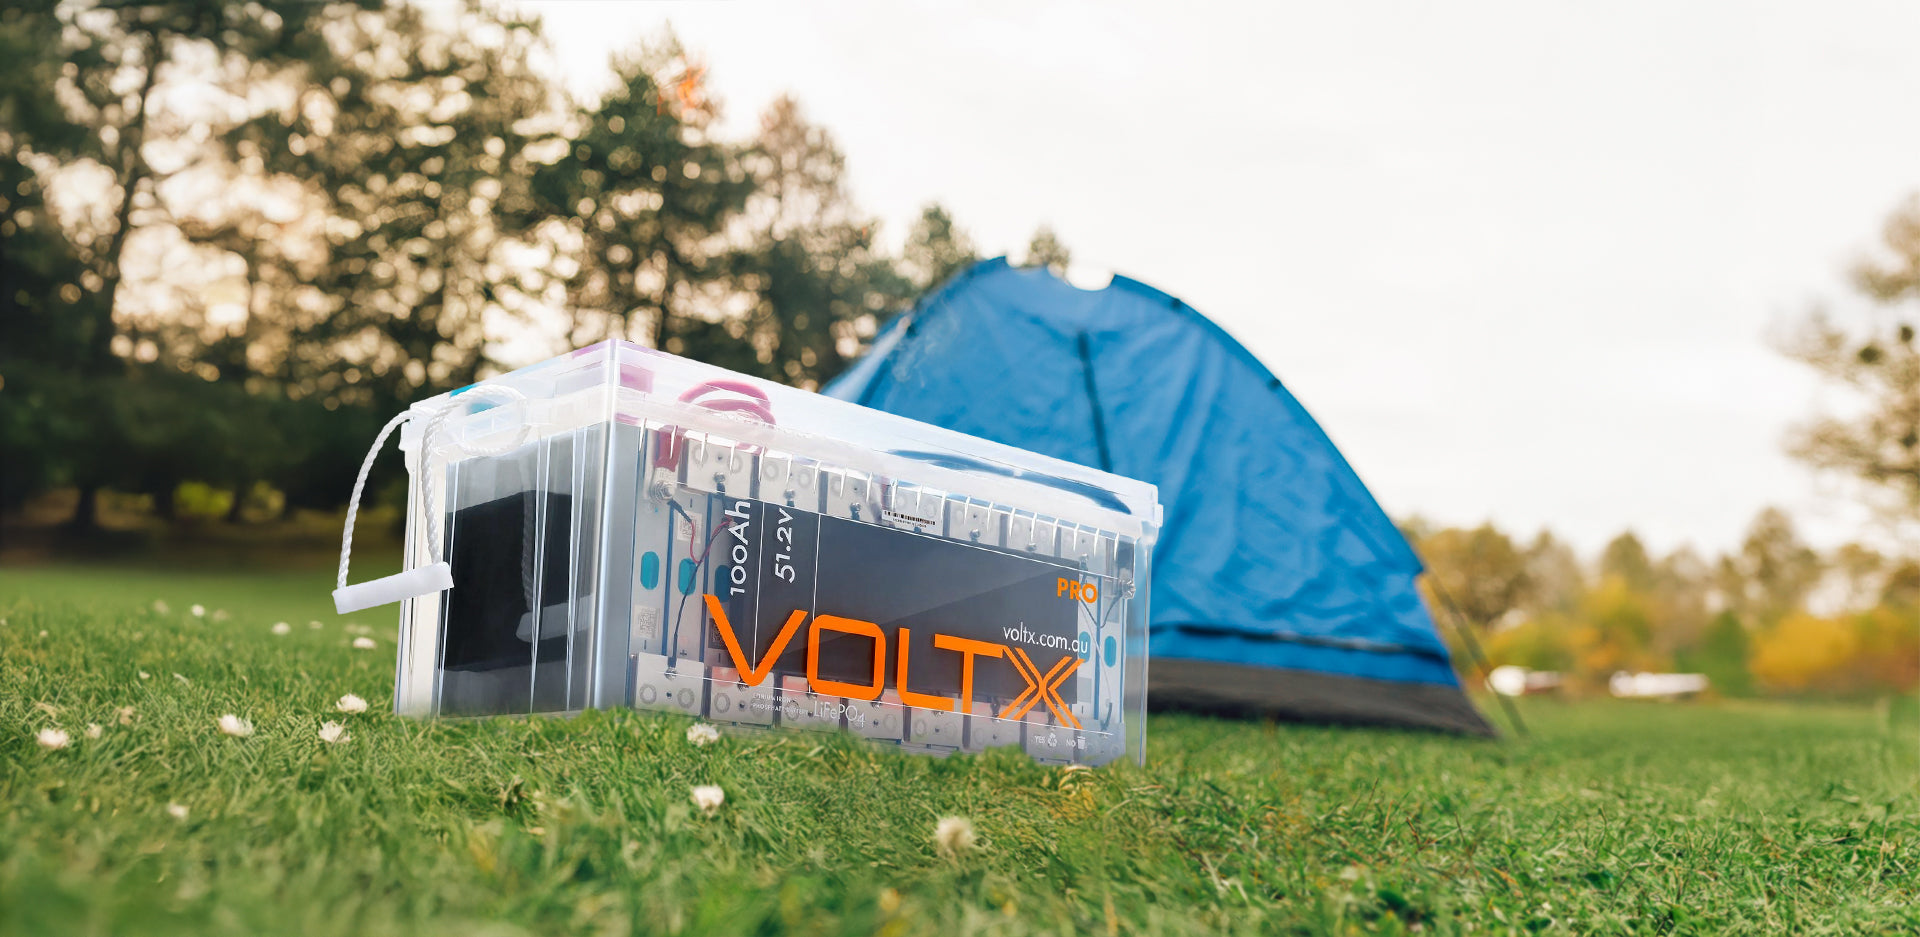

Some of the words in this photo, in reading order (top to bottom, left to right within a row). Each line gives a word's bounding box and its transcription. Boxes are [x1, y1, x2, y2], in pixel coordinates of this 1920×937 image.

[724, 500, 751, 596] 100Ah
[1057, 576, 1098, 604] PRO
[702, 594, 1085, 730] VOLTX
[1002, 621, 1089, 654] voltx.com.au
